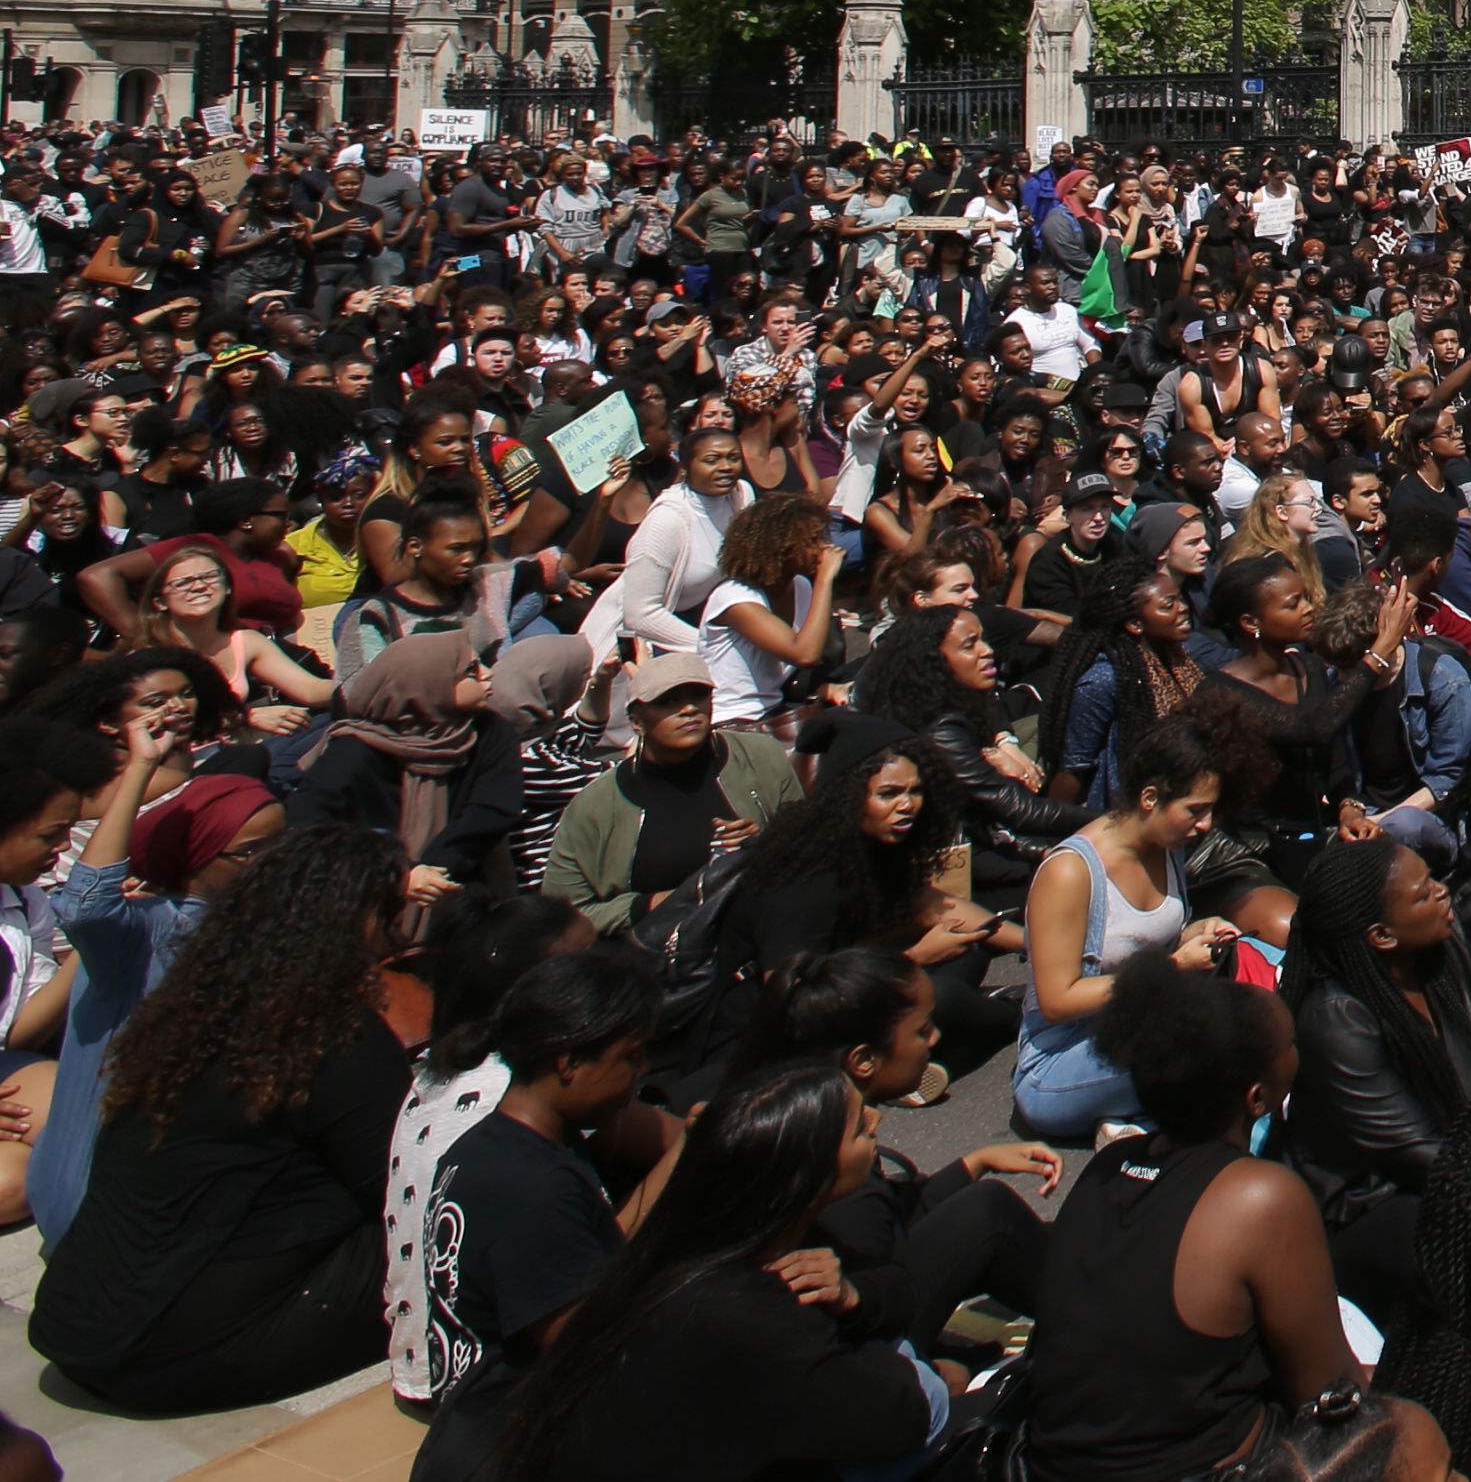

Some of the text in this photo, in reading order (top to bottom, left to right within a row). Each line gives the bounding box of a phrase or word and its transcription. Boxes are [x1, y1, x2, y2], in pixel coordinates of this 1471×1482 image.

[429, 114, 474, 125] SILENCE
[422, 134, 478, 144] COMPLIANCE
[1415, 145, 1435, 160] WE
